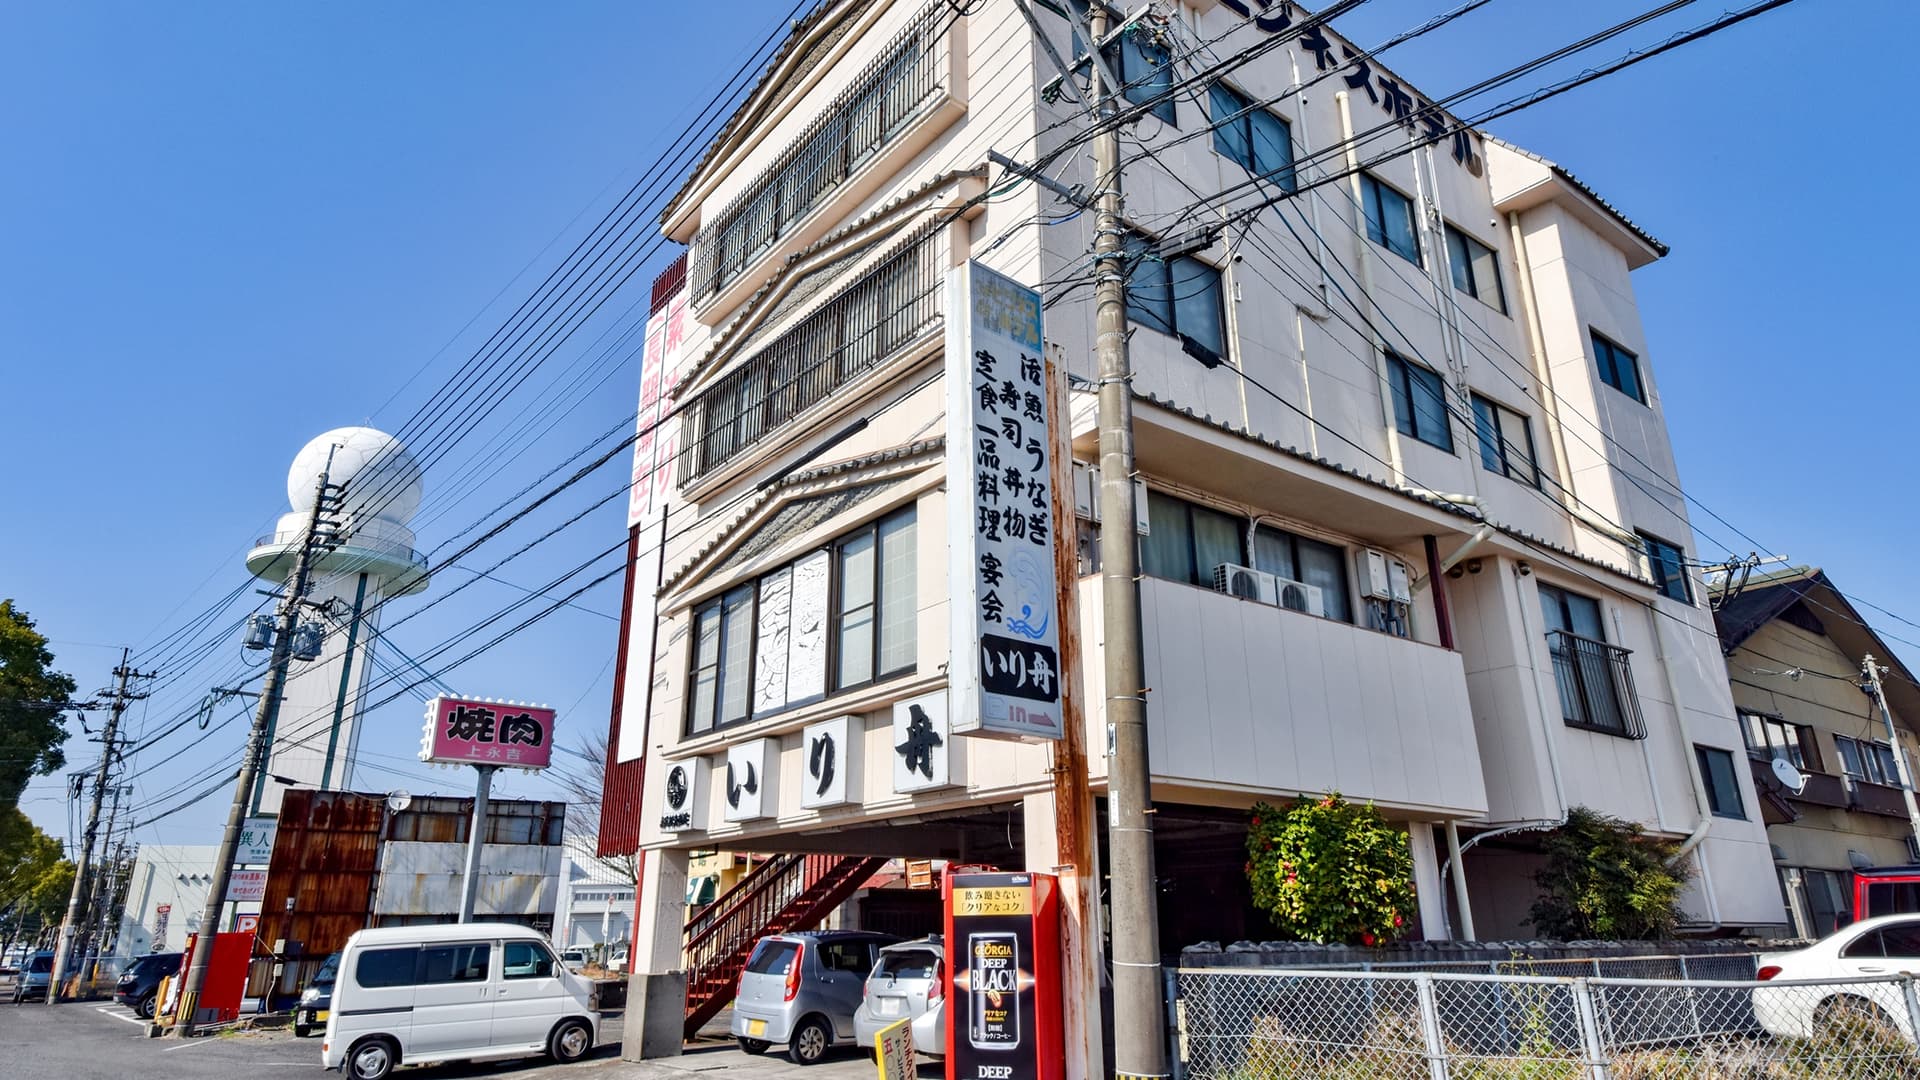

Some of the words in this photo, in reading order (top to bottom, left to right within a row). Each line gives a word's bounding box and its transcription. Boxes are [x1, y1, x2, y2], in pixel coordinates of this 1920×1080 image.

[981, 646, 1056, 696] いり舟
[446, 704, 545, 748] 焼肉
[464, 744, 522, 760] 上永吉
[725, 702, 944, 811] いり舟
[964, 889, 1021, 900] 飲み飽きない
[981, 958, 1007, 969] DEEP
[972, 969, 1016, 991] BLACK
[977, 1065, 1013, 1080] DEEP
